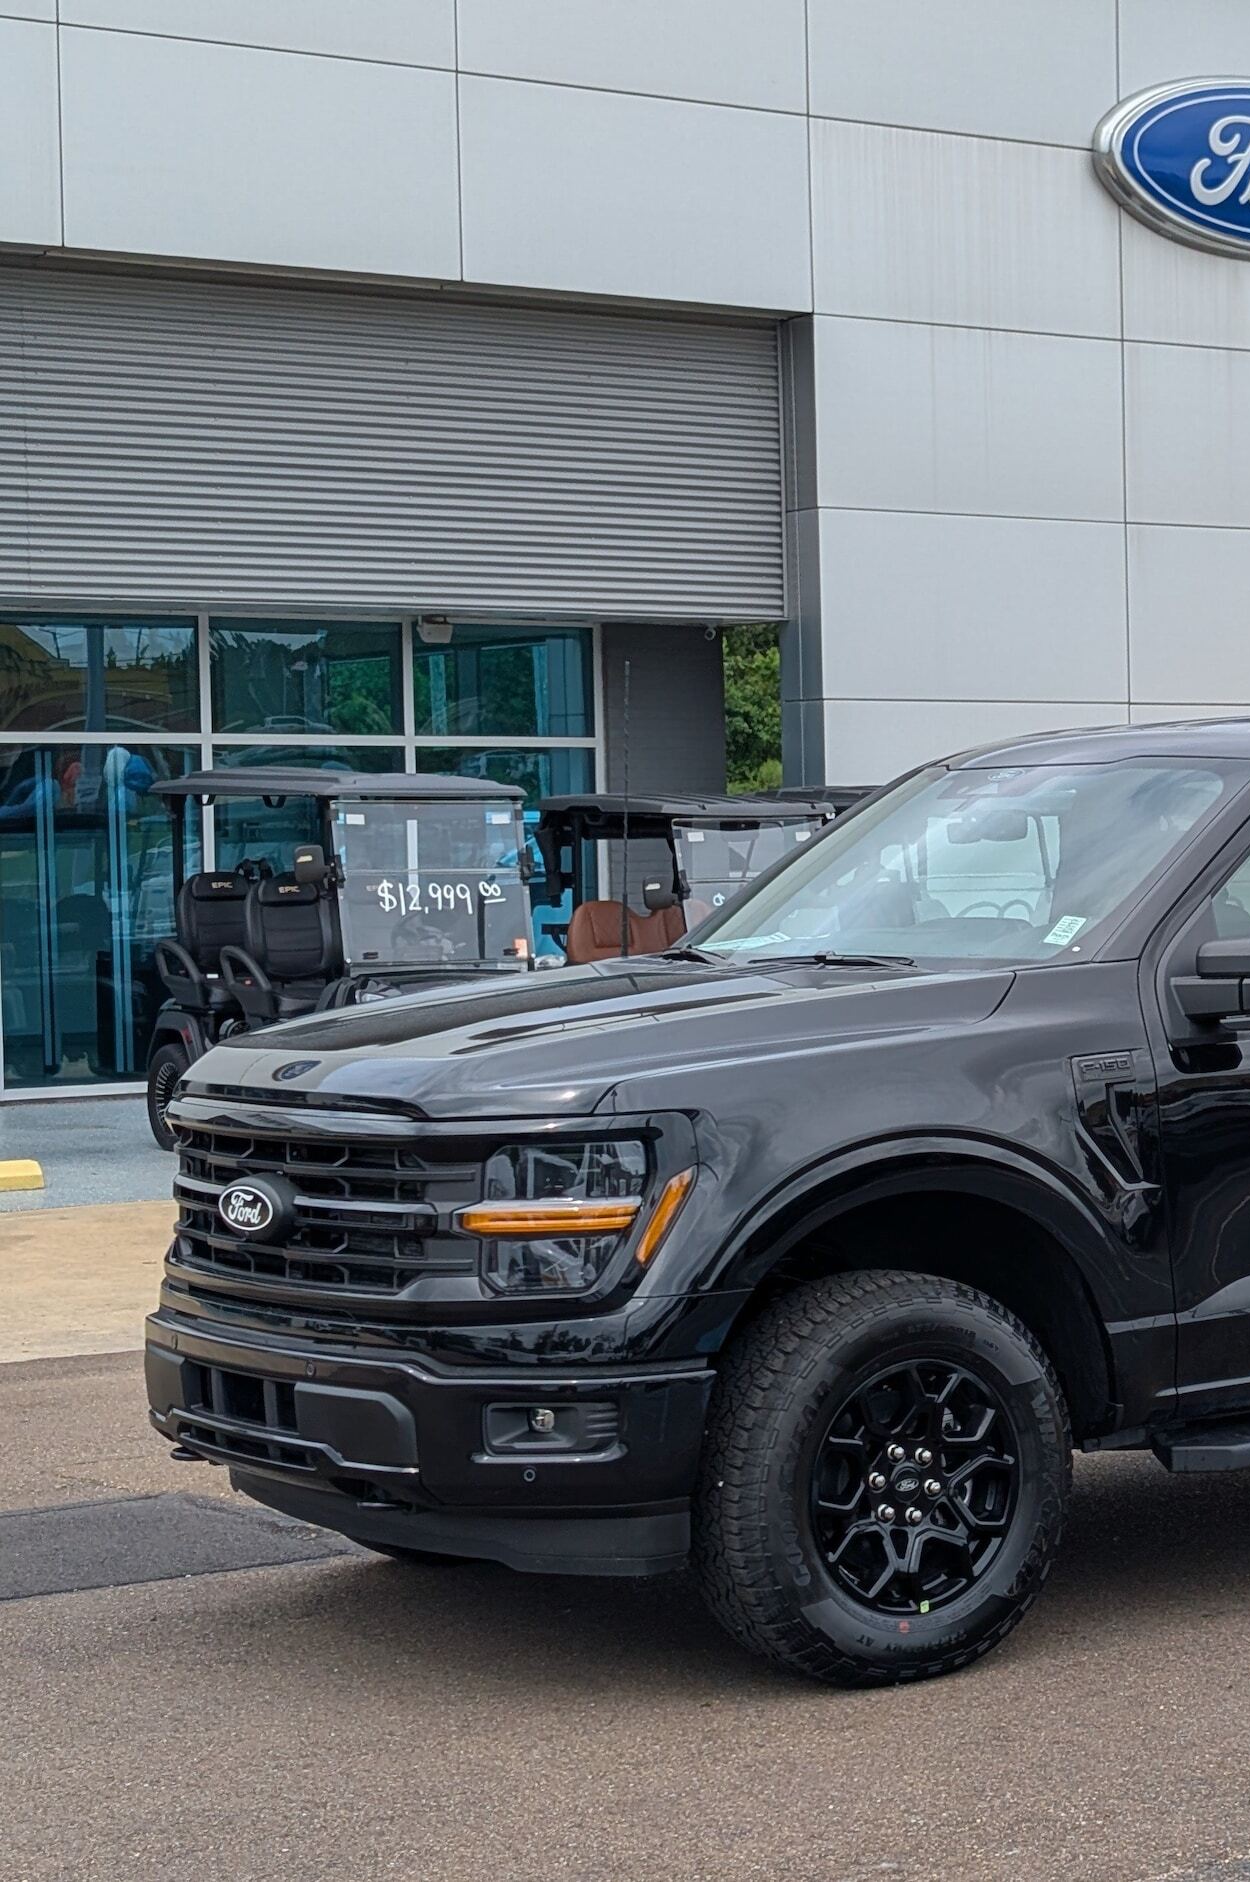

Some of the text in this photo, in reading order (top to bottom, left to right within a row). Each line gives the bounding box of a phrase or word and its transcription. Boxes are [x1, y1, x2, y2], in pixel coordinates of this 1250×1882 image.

[211, 881, 233, 889] EPIC
[278, 885, 301, 893] EPIC
[377, 879, 473, 915] $12,999
[1081, 1057, 1131, 1073] F-150
[228, 1191, 262, 1224] Ford
